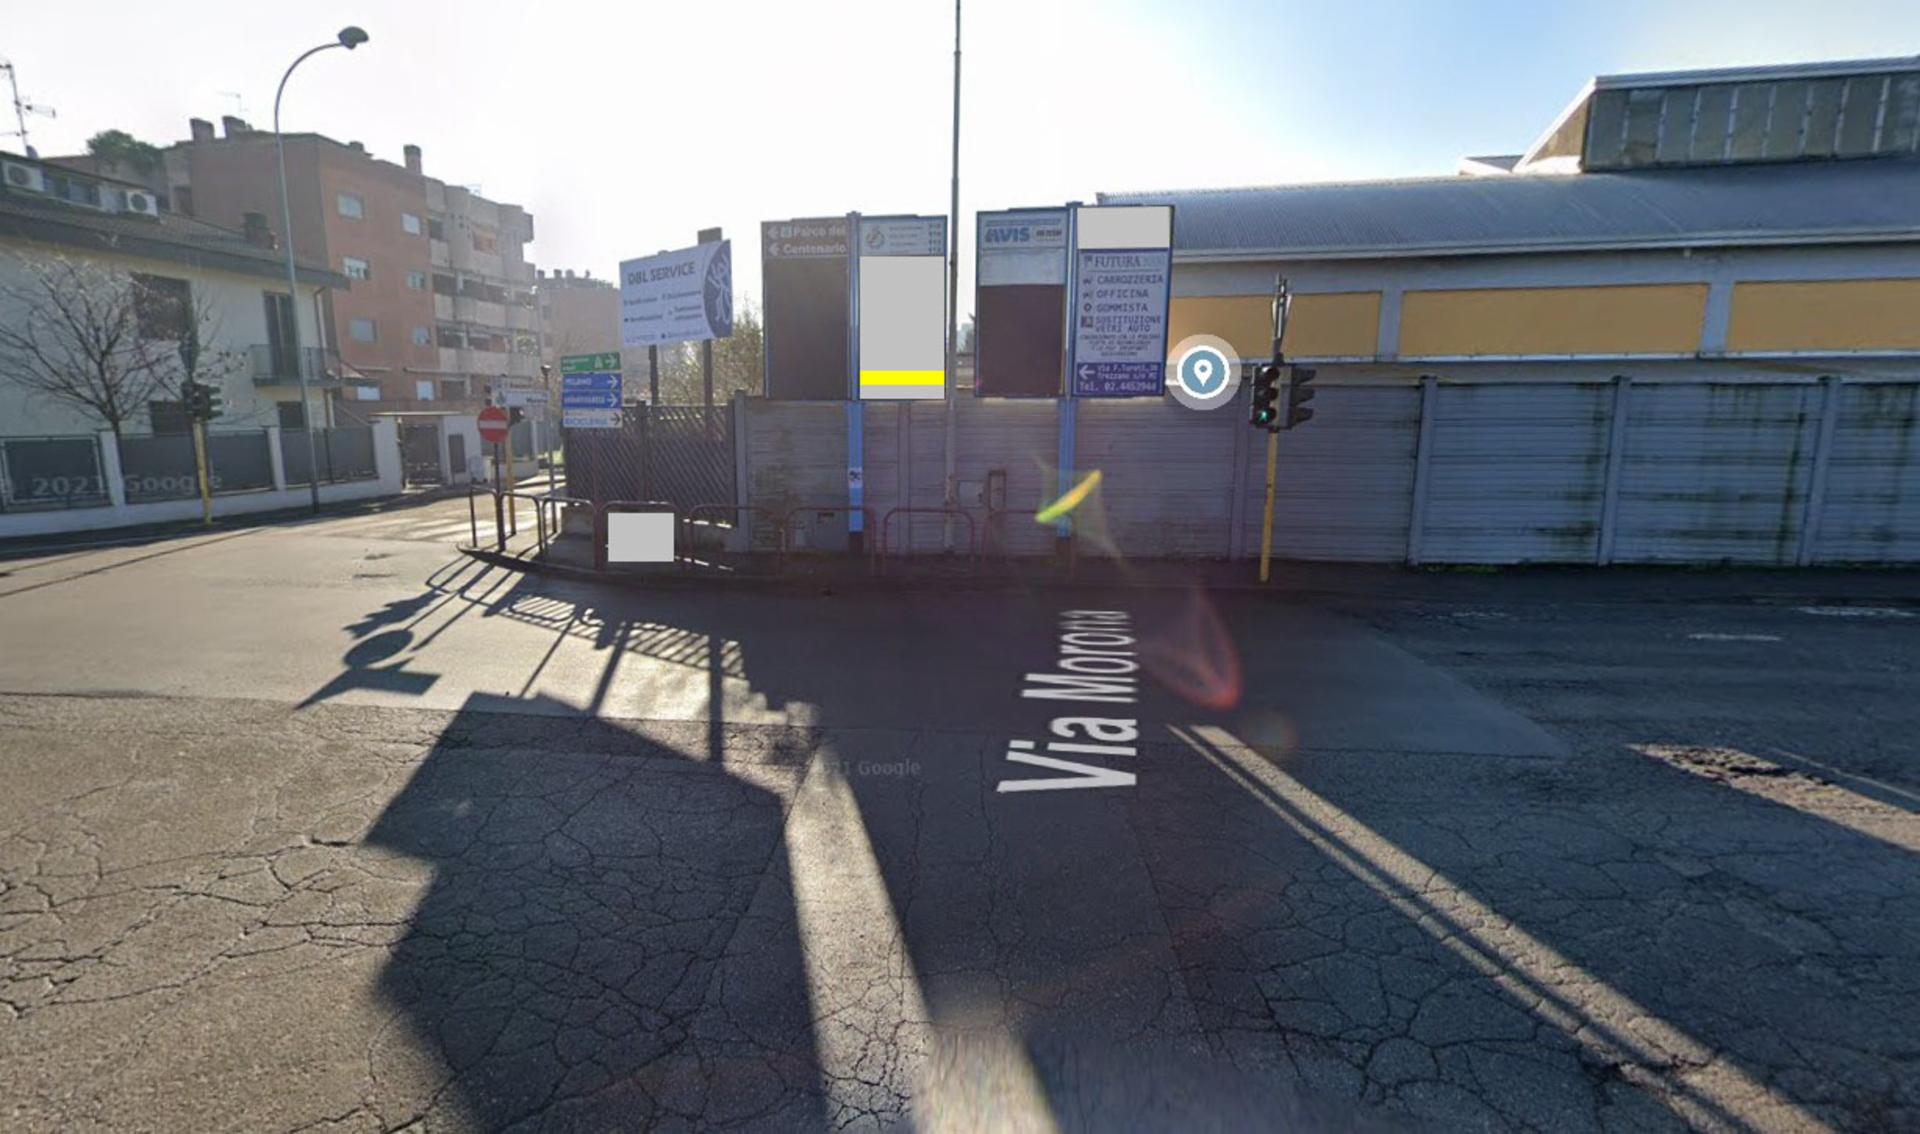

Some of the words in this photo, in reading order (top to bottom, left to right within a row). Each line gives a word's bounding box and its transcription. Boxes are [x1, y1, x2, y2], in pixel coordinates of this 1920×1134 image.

[793, 225, 825, 238] Parco
[985, 227, 1031, 243] AVIS
[783, 242, 847, 257] Centenario
[649, 260, 696, 283] SERVICE
[1096, 273, 1164, 285] CARROZZERIA
[1095, 288, 1150, 299] OFFICINA
[1095, 302, 1149, 313] GOMMISTA
[1127, 324, 1151, 333] AUTO
